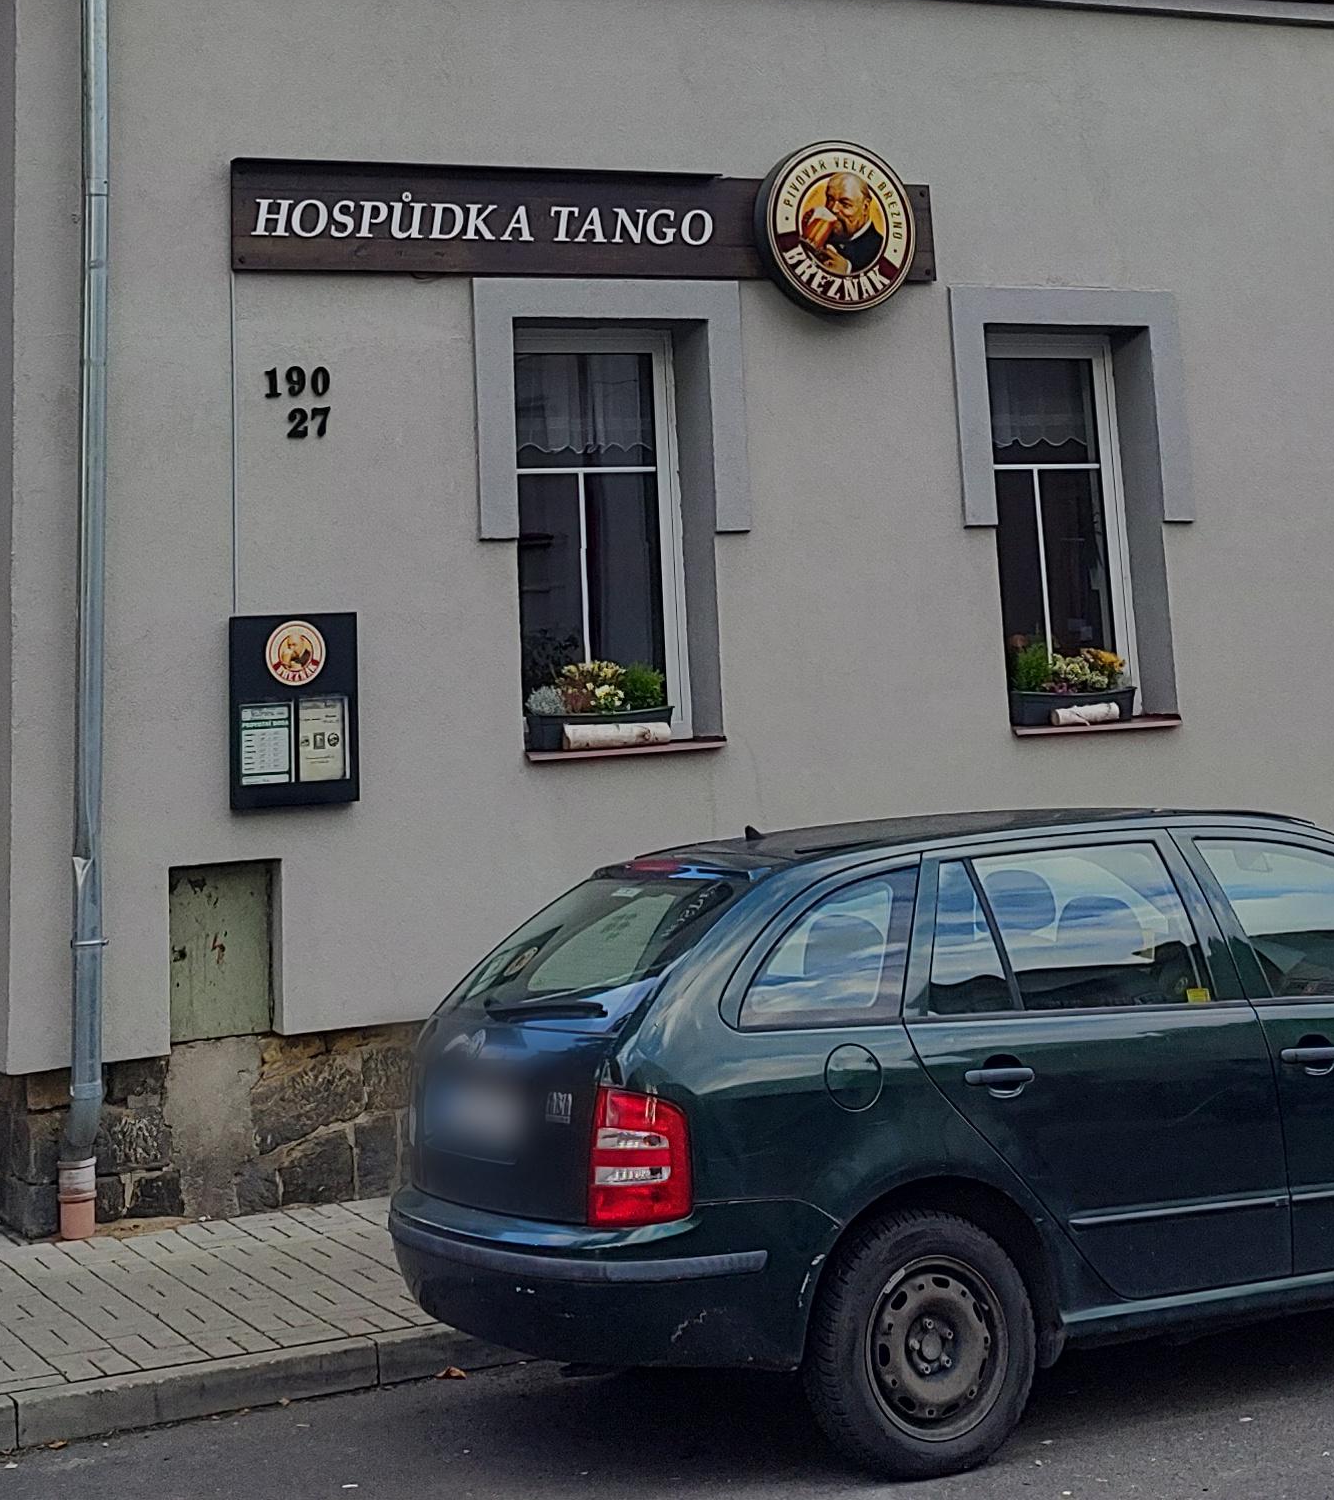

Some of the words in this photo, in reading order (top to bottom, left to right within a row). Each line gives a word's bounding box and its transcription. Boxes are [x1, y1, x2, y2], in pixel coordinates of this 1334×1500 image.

[783, 159, 828, 208] PIVOVAR
[250, 191, 535, 241] HOSPŮDKA
[550, 205, 714, 246] TANGO
[782, 243, 891, 301] BŘEZŇÁK
[264, 365, 331, 398] 190
[286, 405, 331, 438] 27
